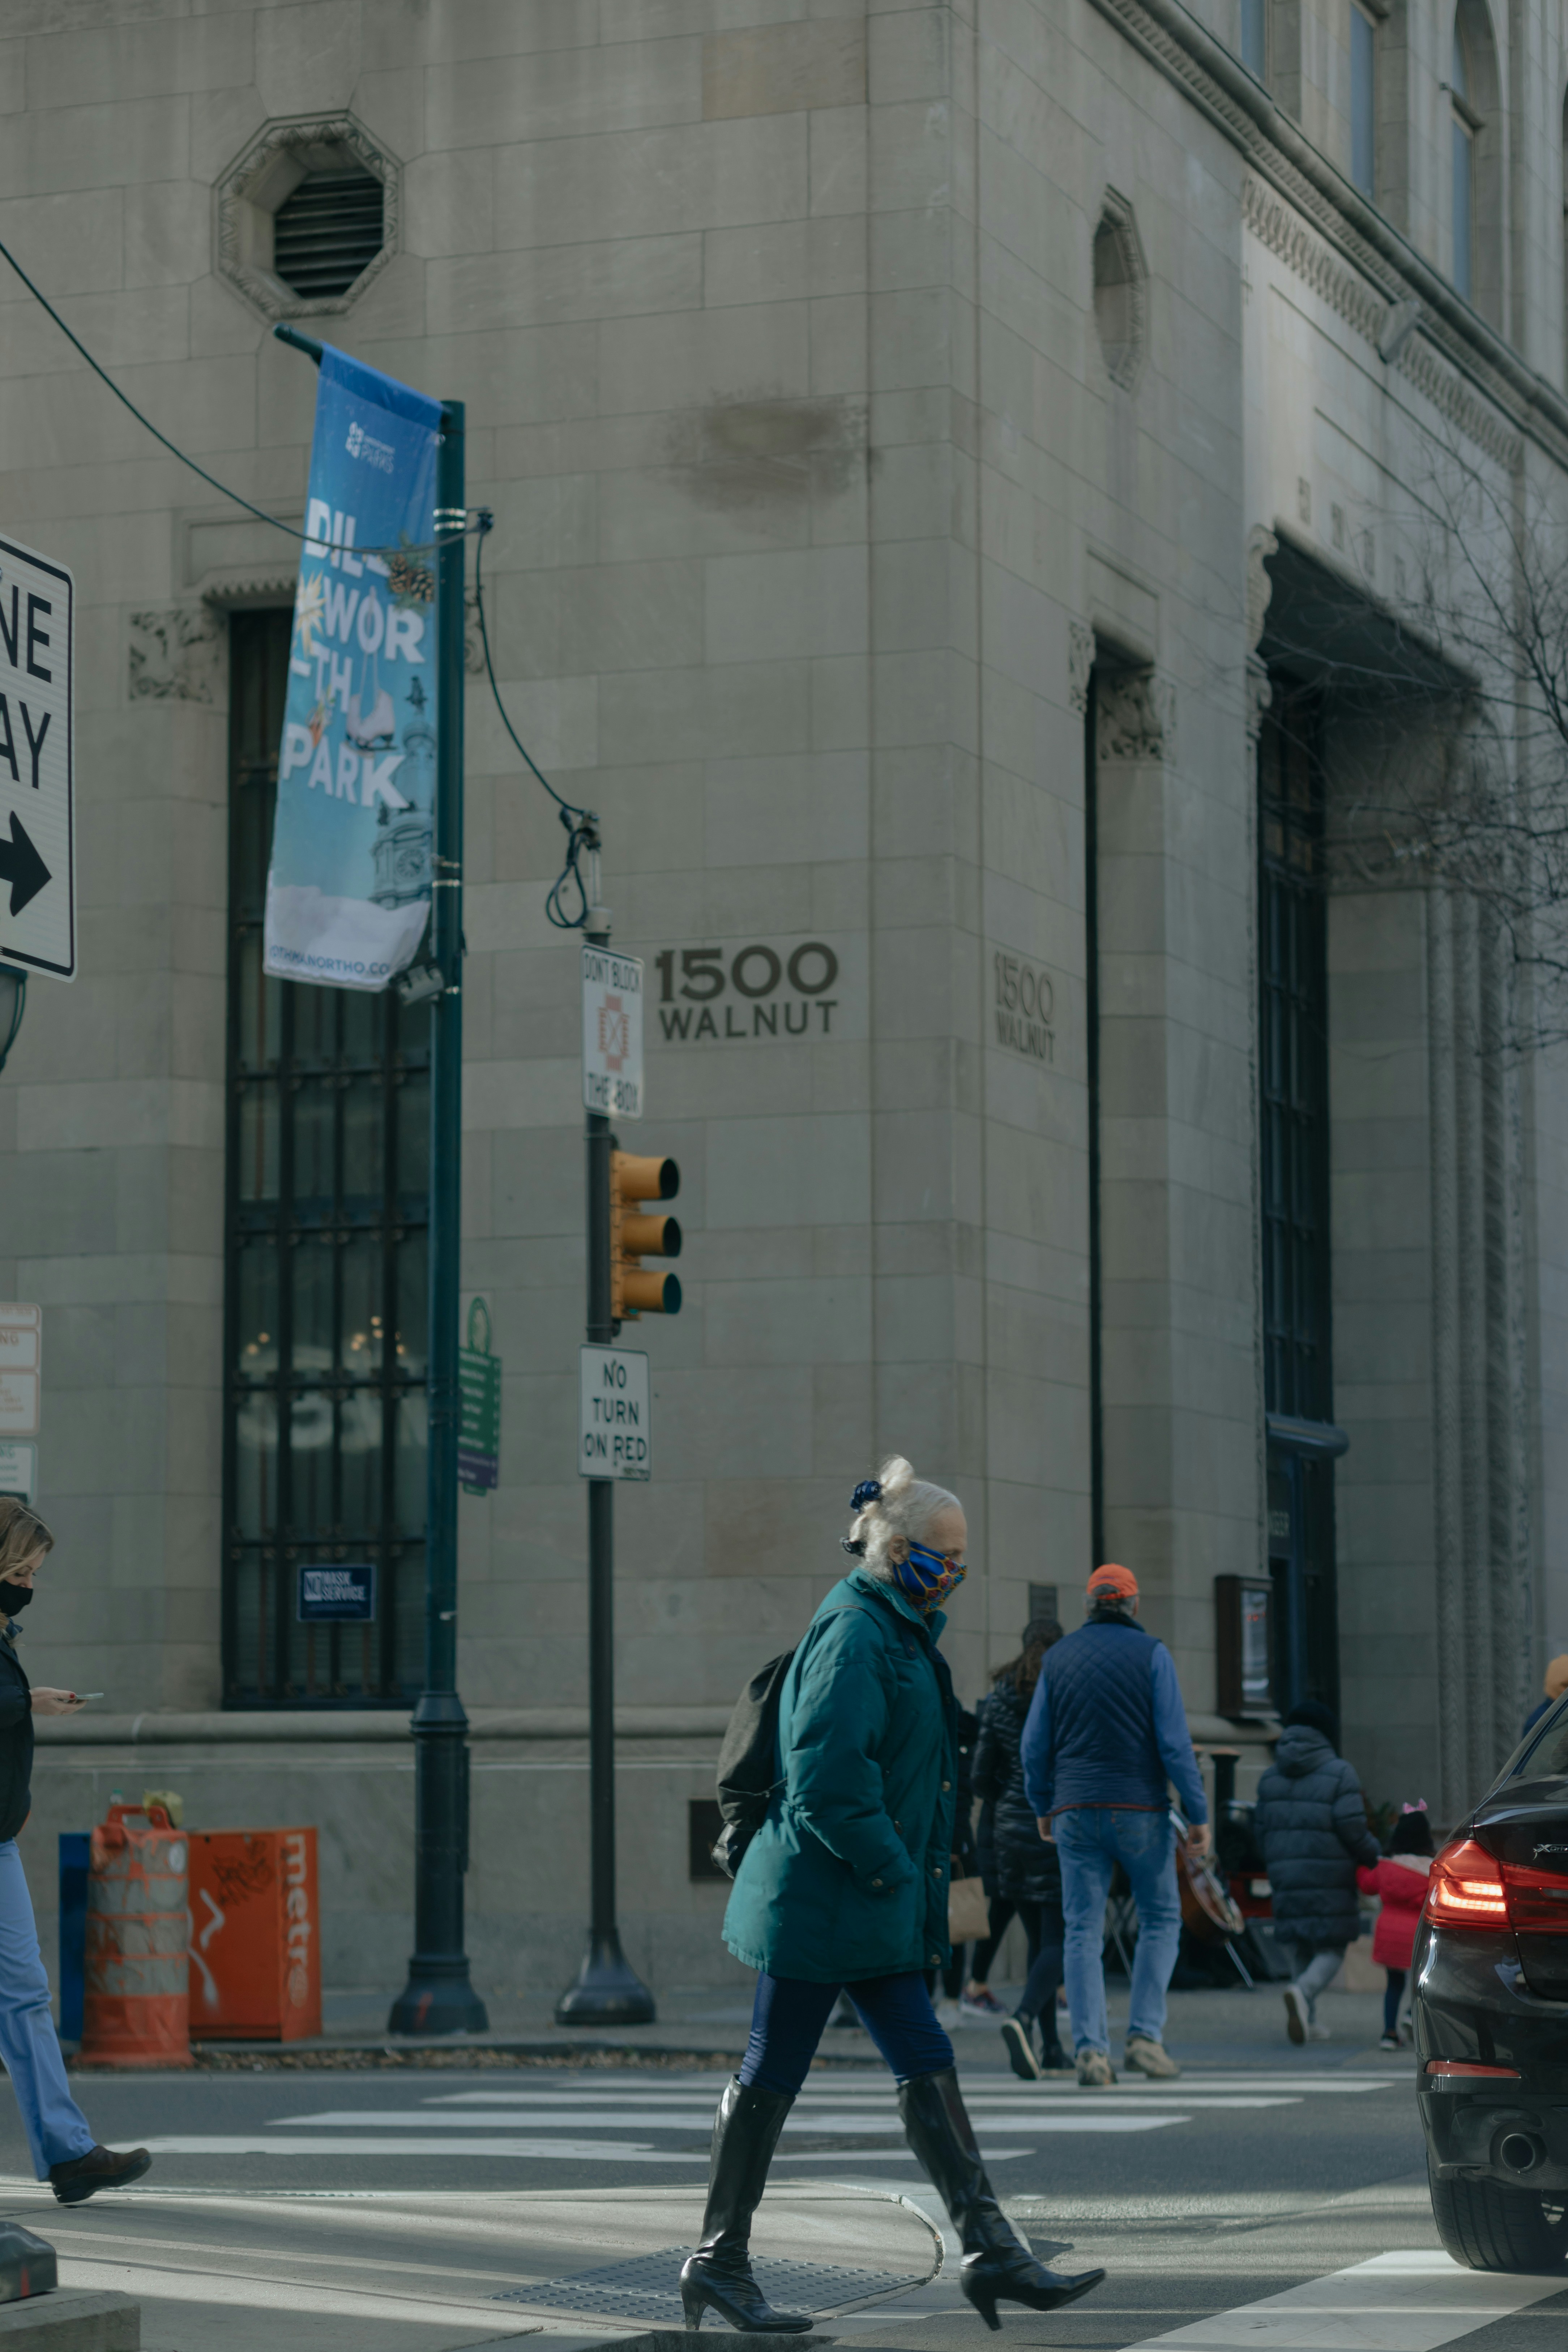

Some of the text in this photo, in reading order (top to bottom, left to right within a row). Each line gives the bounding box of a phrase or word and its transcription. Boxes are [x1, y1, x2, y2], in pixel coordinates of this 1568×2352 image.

[283, 722, 409, 808] PARK
[612, 961, 640, 993] BLOCK
[655, 941, 838, 1002] 1500
[994, 951, 1054, 1025] 1500
[659, 1001, 838, 1041] WALNUT
[995, 1010, 1056, 1064] WALNUT
[587, 1072, 638, 1113] THE BOX
[604, 1361, 627, 1388] NO
[593, 1398, 639, 1426] TURN
[584, 1432, 646, 1461] ON RED
